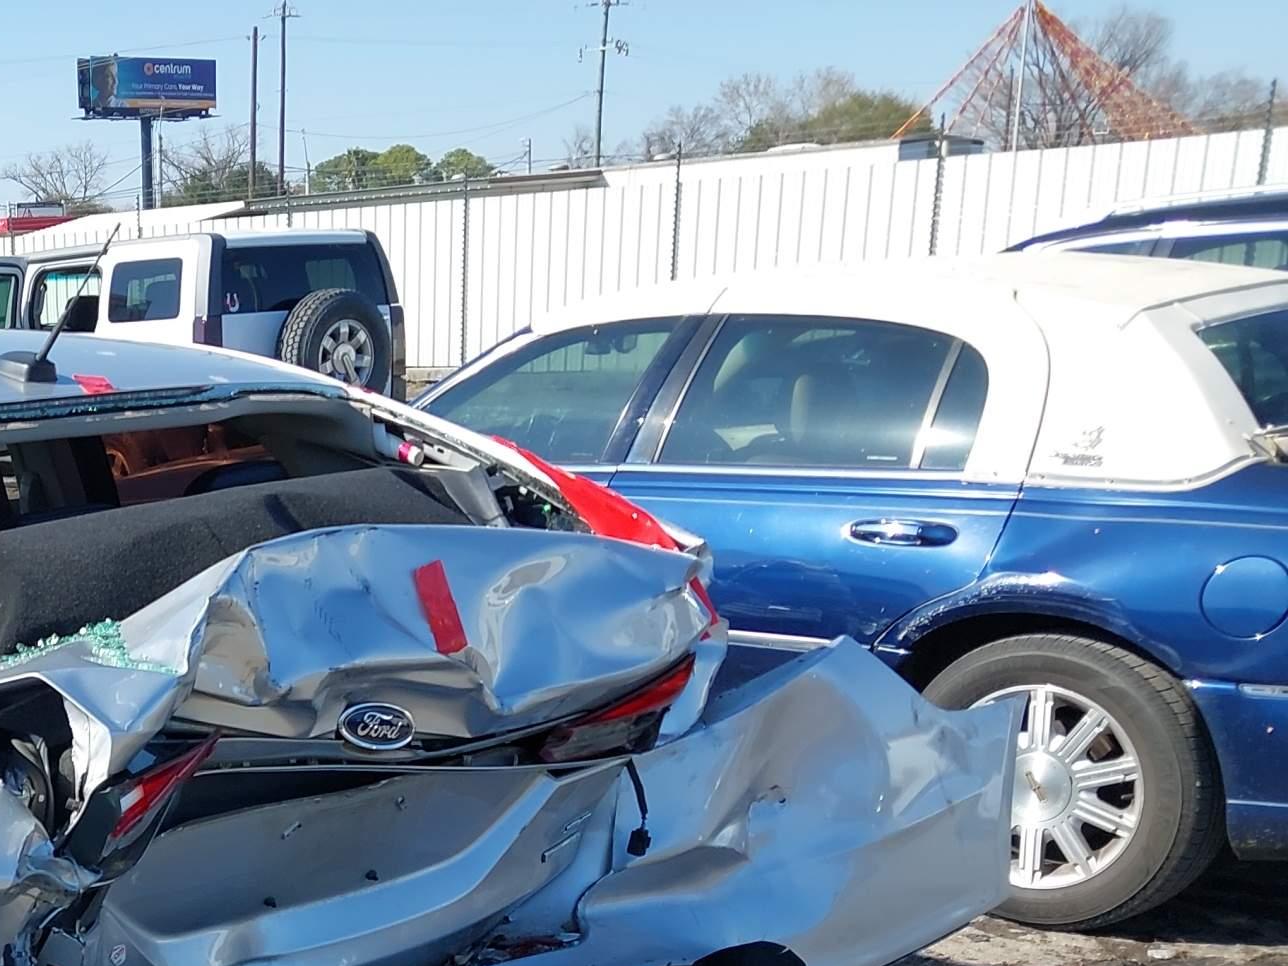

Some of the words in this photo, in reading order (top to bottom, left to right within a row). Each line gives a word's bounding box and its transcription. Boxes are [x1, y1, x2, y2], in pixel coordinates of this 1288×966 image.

[154, 63, 191, 75] centrum
[192, 83, 204, 92] Way
[357, 712, 401, 739] Ford
